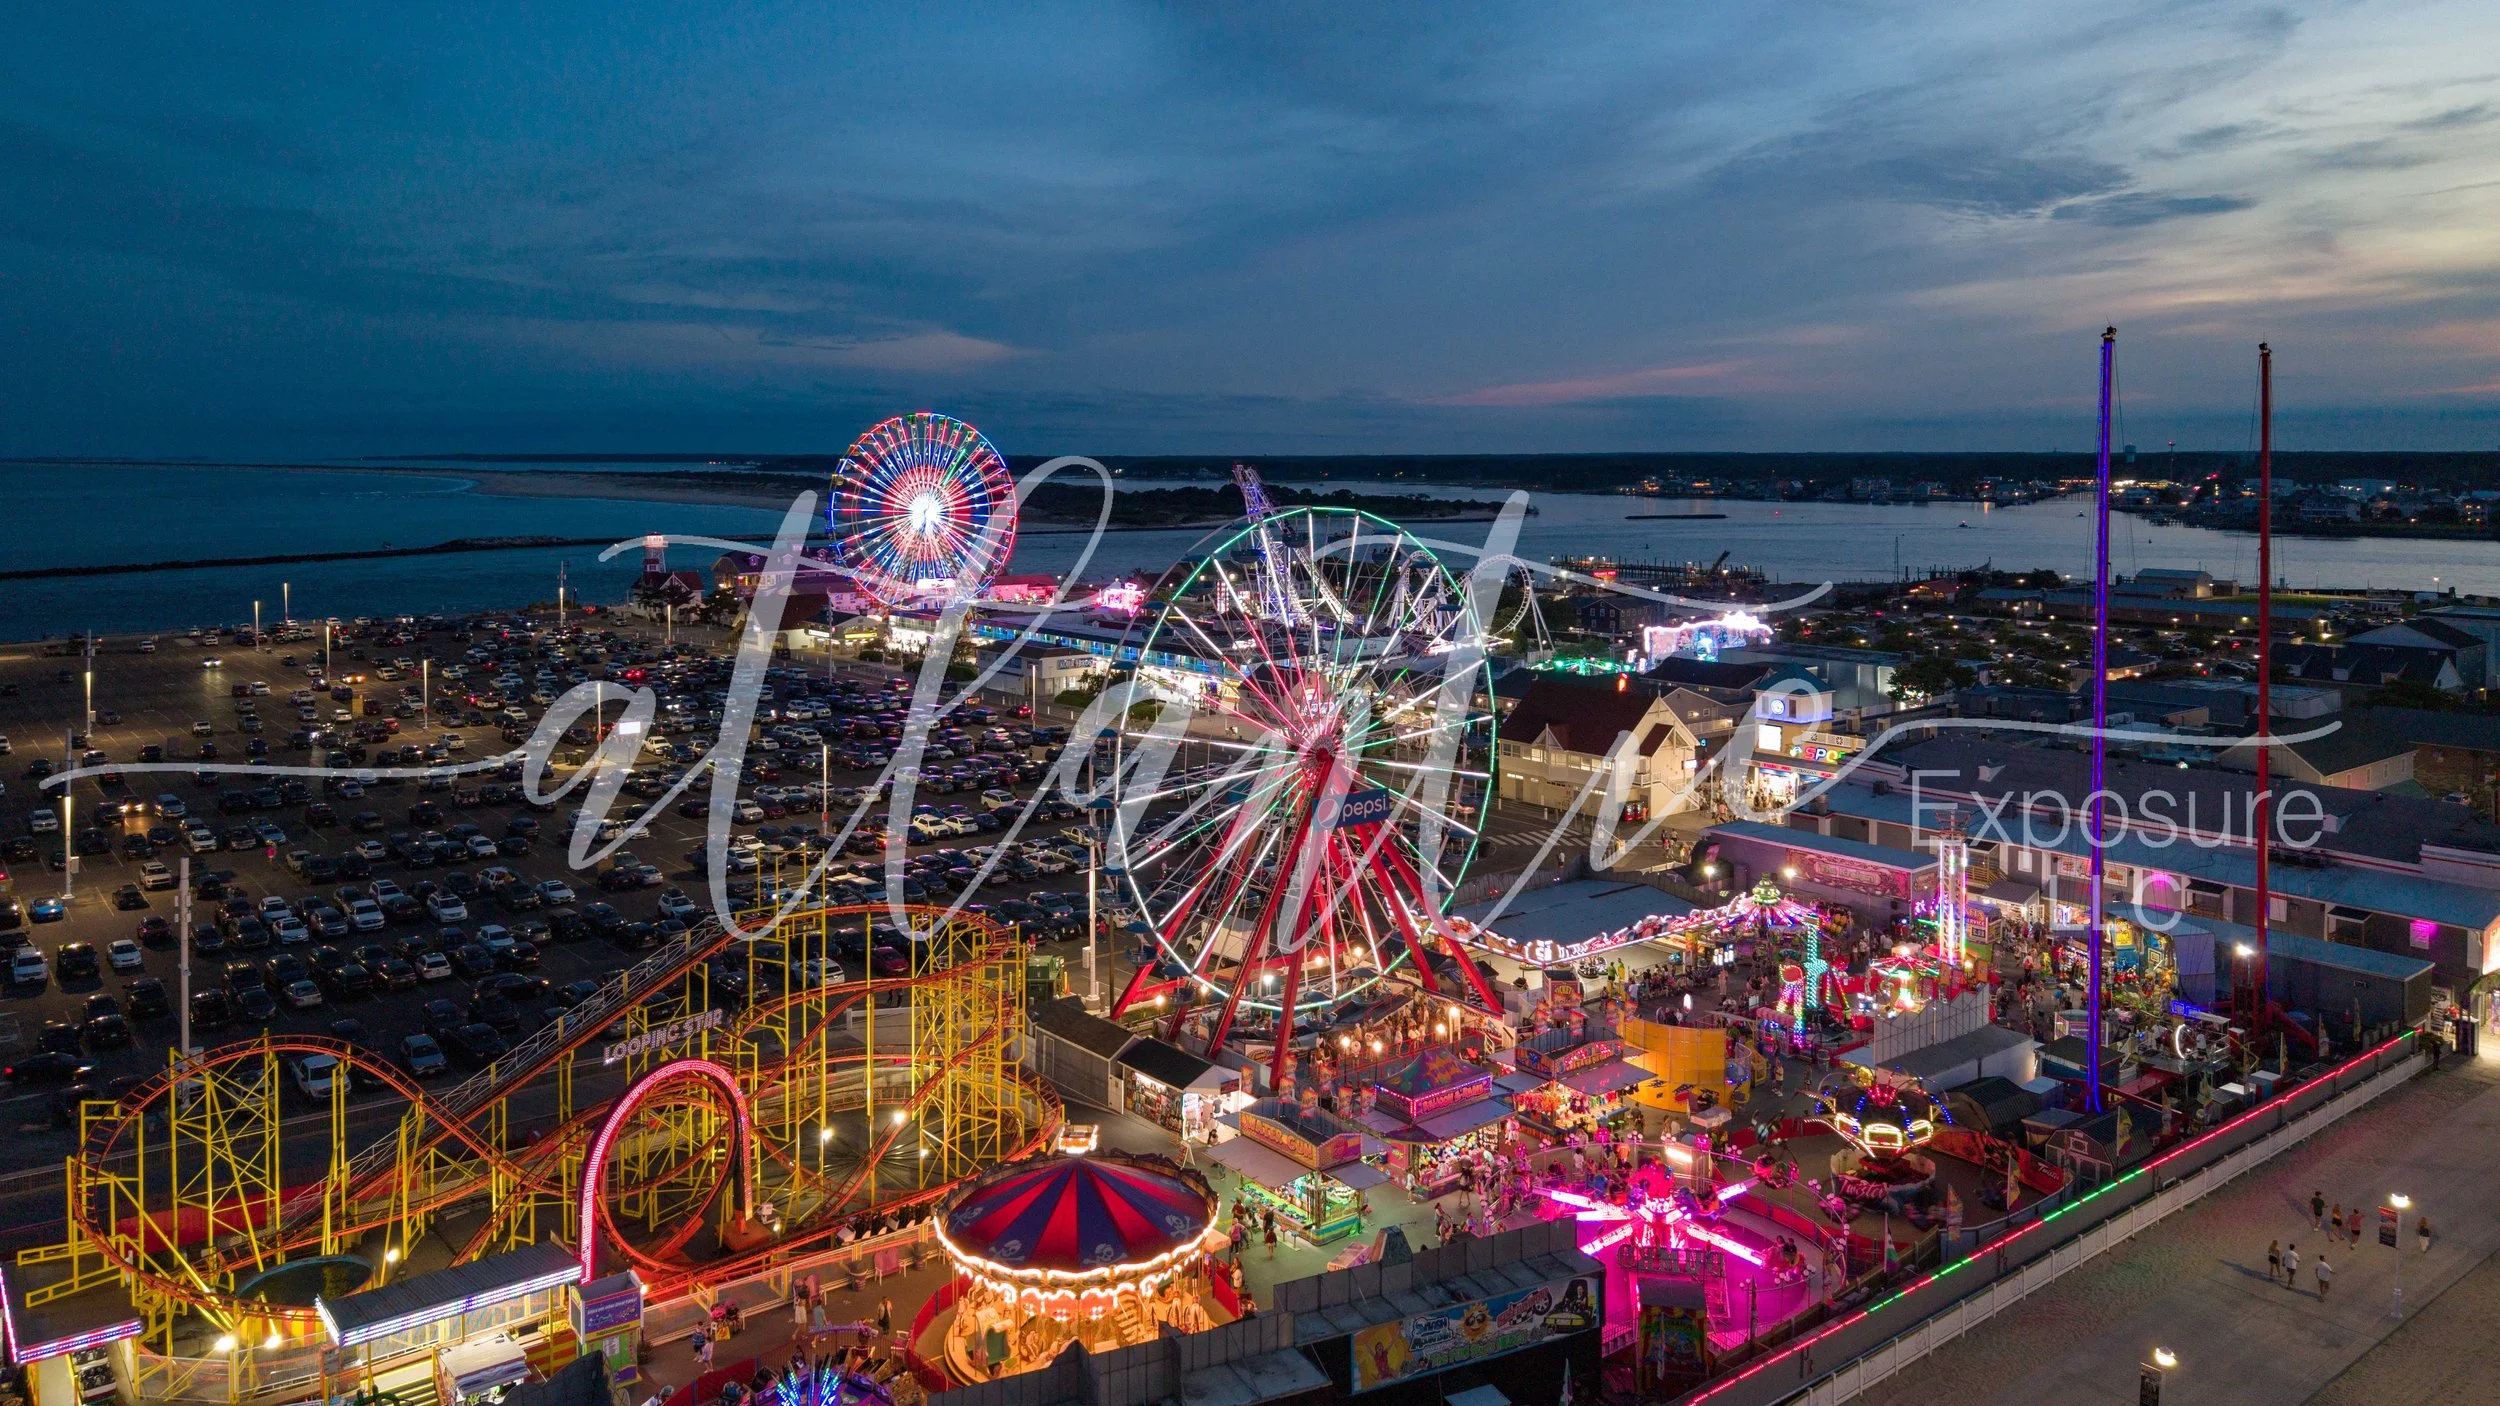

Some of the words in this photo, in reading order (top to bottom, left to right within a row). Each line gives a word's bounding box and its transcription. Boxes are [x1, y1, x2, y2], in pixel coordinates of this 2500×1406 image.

[1342, 794, 1387, 822] pepsi
[603, 1024, 680, 1066] LOOPING
[682, 1008, 722, 1038] STAR
[1241, 1112, 1282, 1145] WATER
[1287, 1134, 1314, 1160] GUN
[1840, 1176, 1886, 1200] Twister
